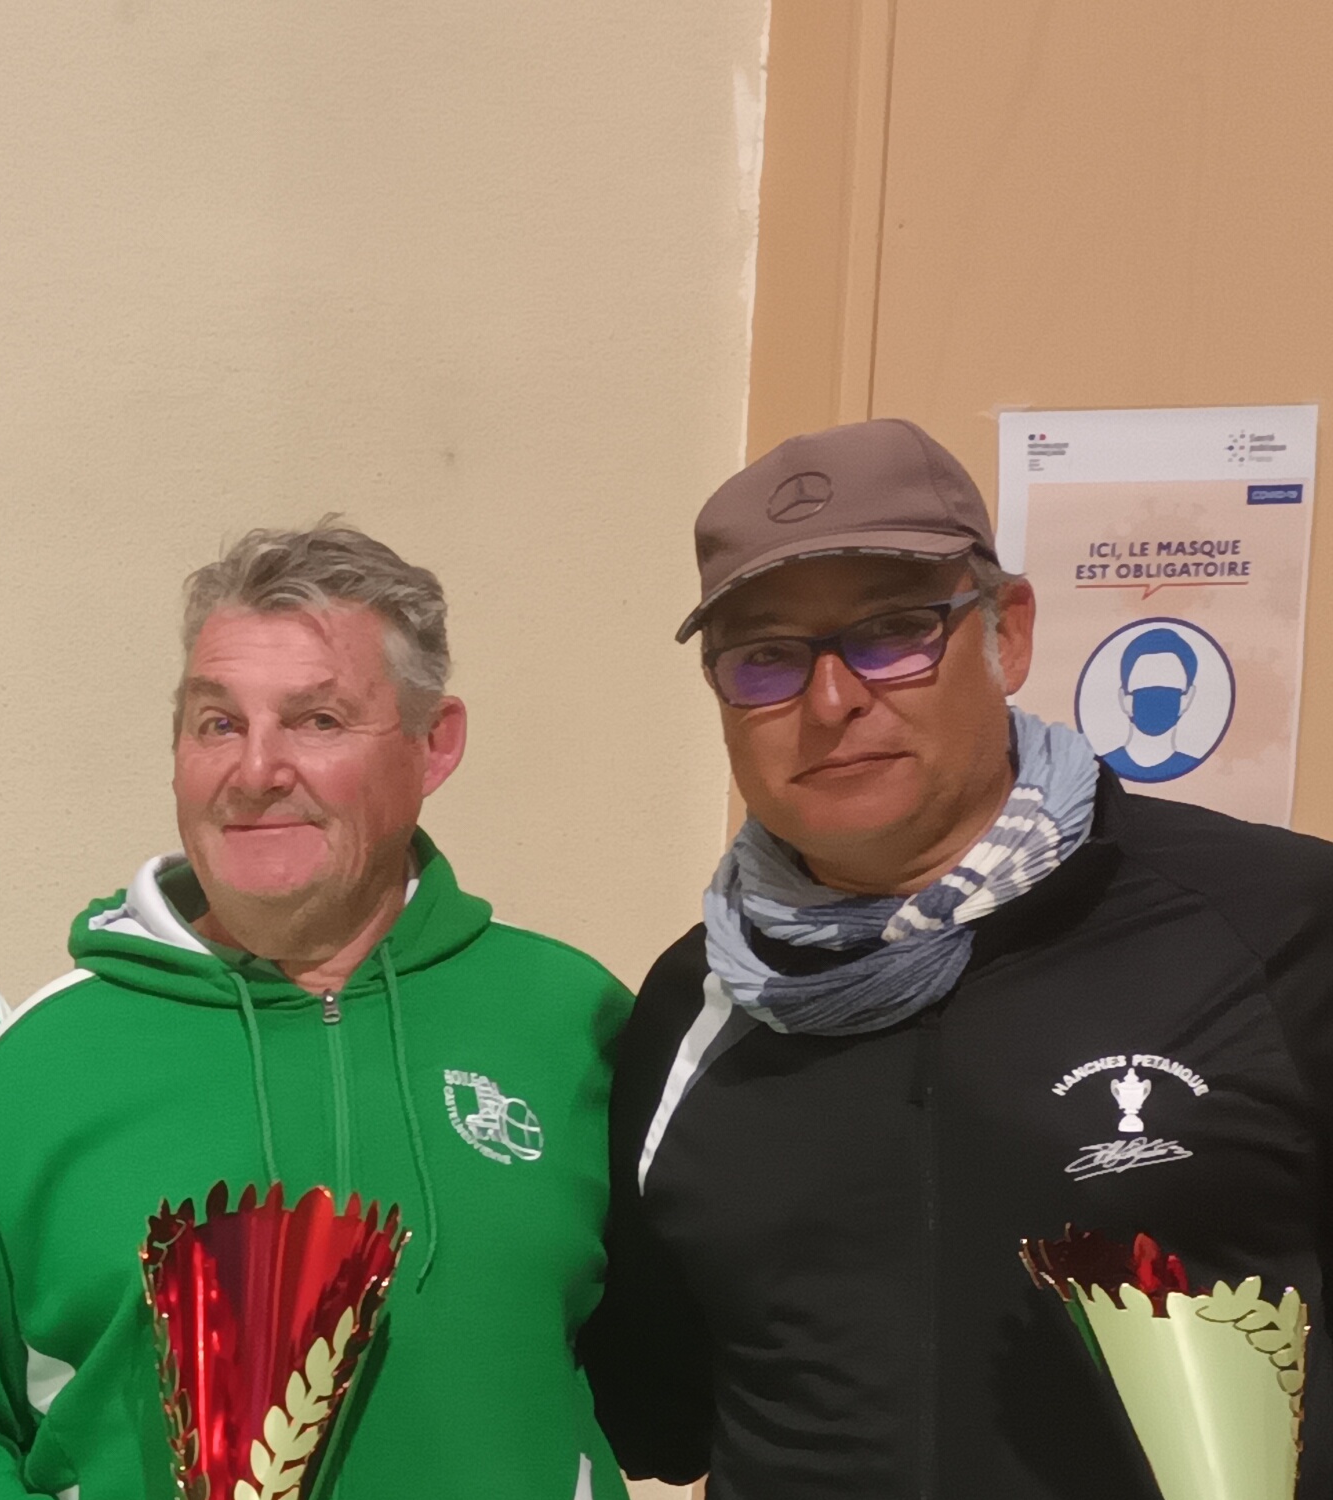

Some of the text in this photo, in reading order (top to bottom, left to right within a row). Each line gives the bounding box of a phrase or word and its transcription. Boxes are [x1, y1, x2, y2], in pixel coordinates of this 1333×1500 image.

[1088, 540, 1241, 561] ICI, LE MASQUE
[1075, 561, 1251, 580] EST OBLIGATOIRE
